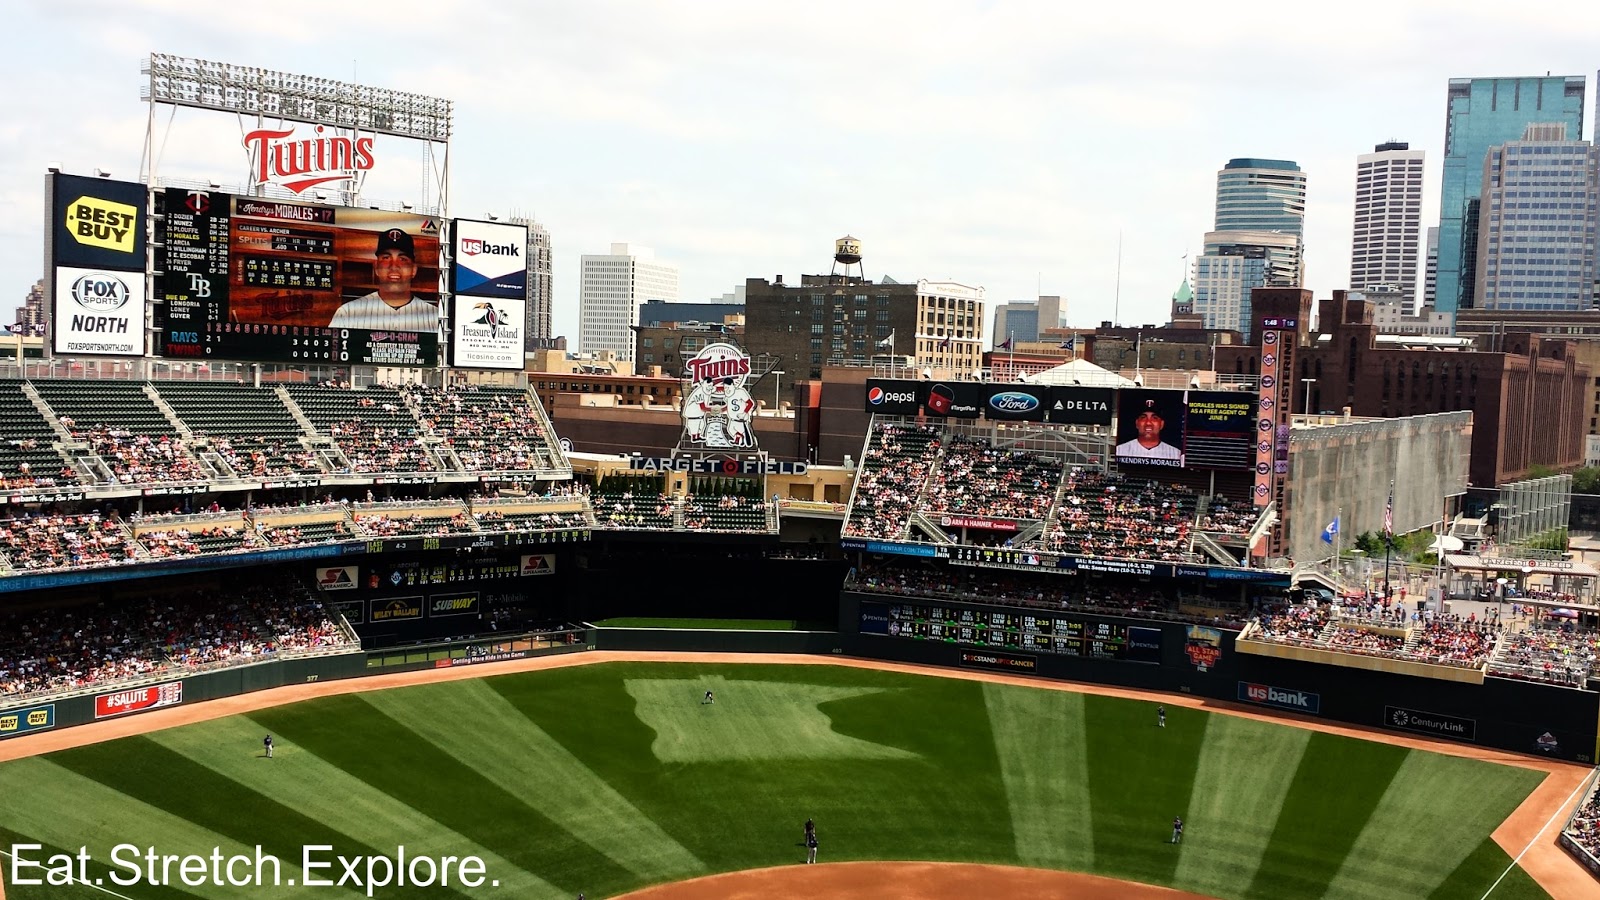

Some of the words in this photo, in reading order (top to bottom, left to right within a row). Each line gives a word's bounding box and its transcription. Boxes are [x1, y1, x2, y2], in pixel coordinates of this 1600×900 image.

[243, 124, 375, 183] Twins
[76, 204, 134, 229] BEST
[274, 204, 313, 221] MORALES
[77, 220, 128, 243] BUY
[173, 226, 199, 234] PLOUFFE
[239, 224, 260, 232] CAREER
[173, 232, 200, 240] MORALES
[238, 235, 268, 245] SPLITS
[173, 246, 207, 254] WILLINGHAM
[179, 252, 206, 260] ESCOBAR
[172, 264, 188, 272] FULD
[84, 279, 118, 298] FOX
[83, 296, 119, 305] SPORTS
[71, 314, 129, 334] NORTH
[171, 331, 198, 343] RAYS
[461, 324, 491, 338] Treasure
[497, 327, 519, 339] Island
[67, 342, 134, 352] FOXSPORTSNORTH.COM
[167, 344, 202, 355] TWINS
[466, 353, 512, 361] ticasino.com
[687, 356, 750, 384] Twins
[1281, 334, 1292, 411] LISTERINE
[884, 391, 915, 404] pepsi
[998, 394, 1029, 410] Ford
[951, 404, 976, 412] #TargetRun
[1067, 400, 1107, 411] DELTA
[632, 456, 721, 473] TARGET
[743, 461, 808, 475] FIELD
[1121, 457, 1150, 465] KENDRYS
[1150, 458, 1180, 467] MORALES
[969, 521, 993, 529] HAMMER
[432, 598, 476, 611] SUBWAY
[373, 610, 392, 620] WILEY
[393, 607, 420, 617] WALLABY
[1193, 653, 1213, 661] GAME
[1202, 648, 1219, 657] STAR
[107, 689, 148, 708] #SALUTE
[1411, 716, 1464, 733] CenturyLink
